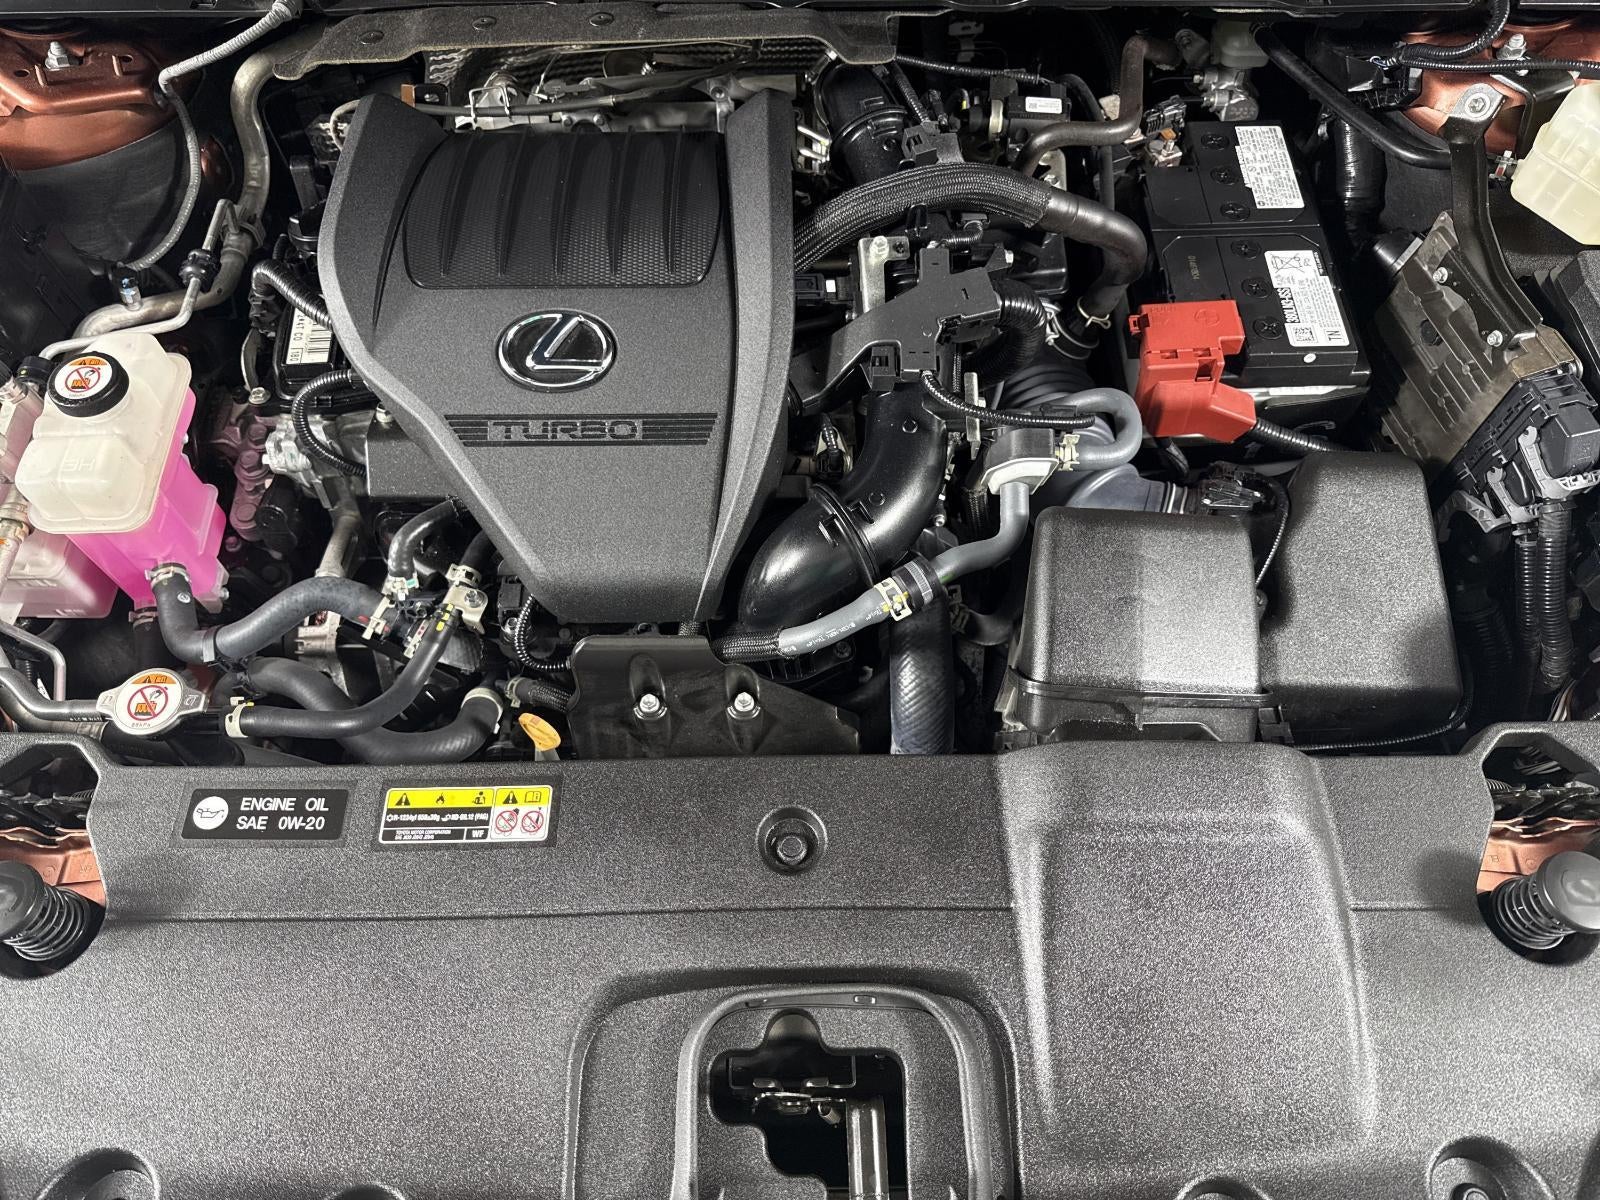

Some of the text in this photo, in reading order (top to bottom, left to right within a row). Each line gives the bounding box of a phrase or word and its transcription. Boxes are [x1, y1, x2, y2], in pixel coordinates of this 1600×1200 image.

[492, 421, 638, 440] TURBO
[240, 797, 329, 812] ENGINE OIL
[235, 815, 326, 830] SAE 0W-20
[471, 829, 485, 838] WF
